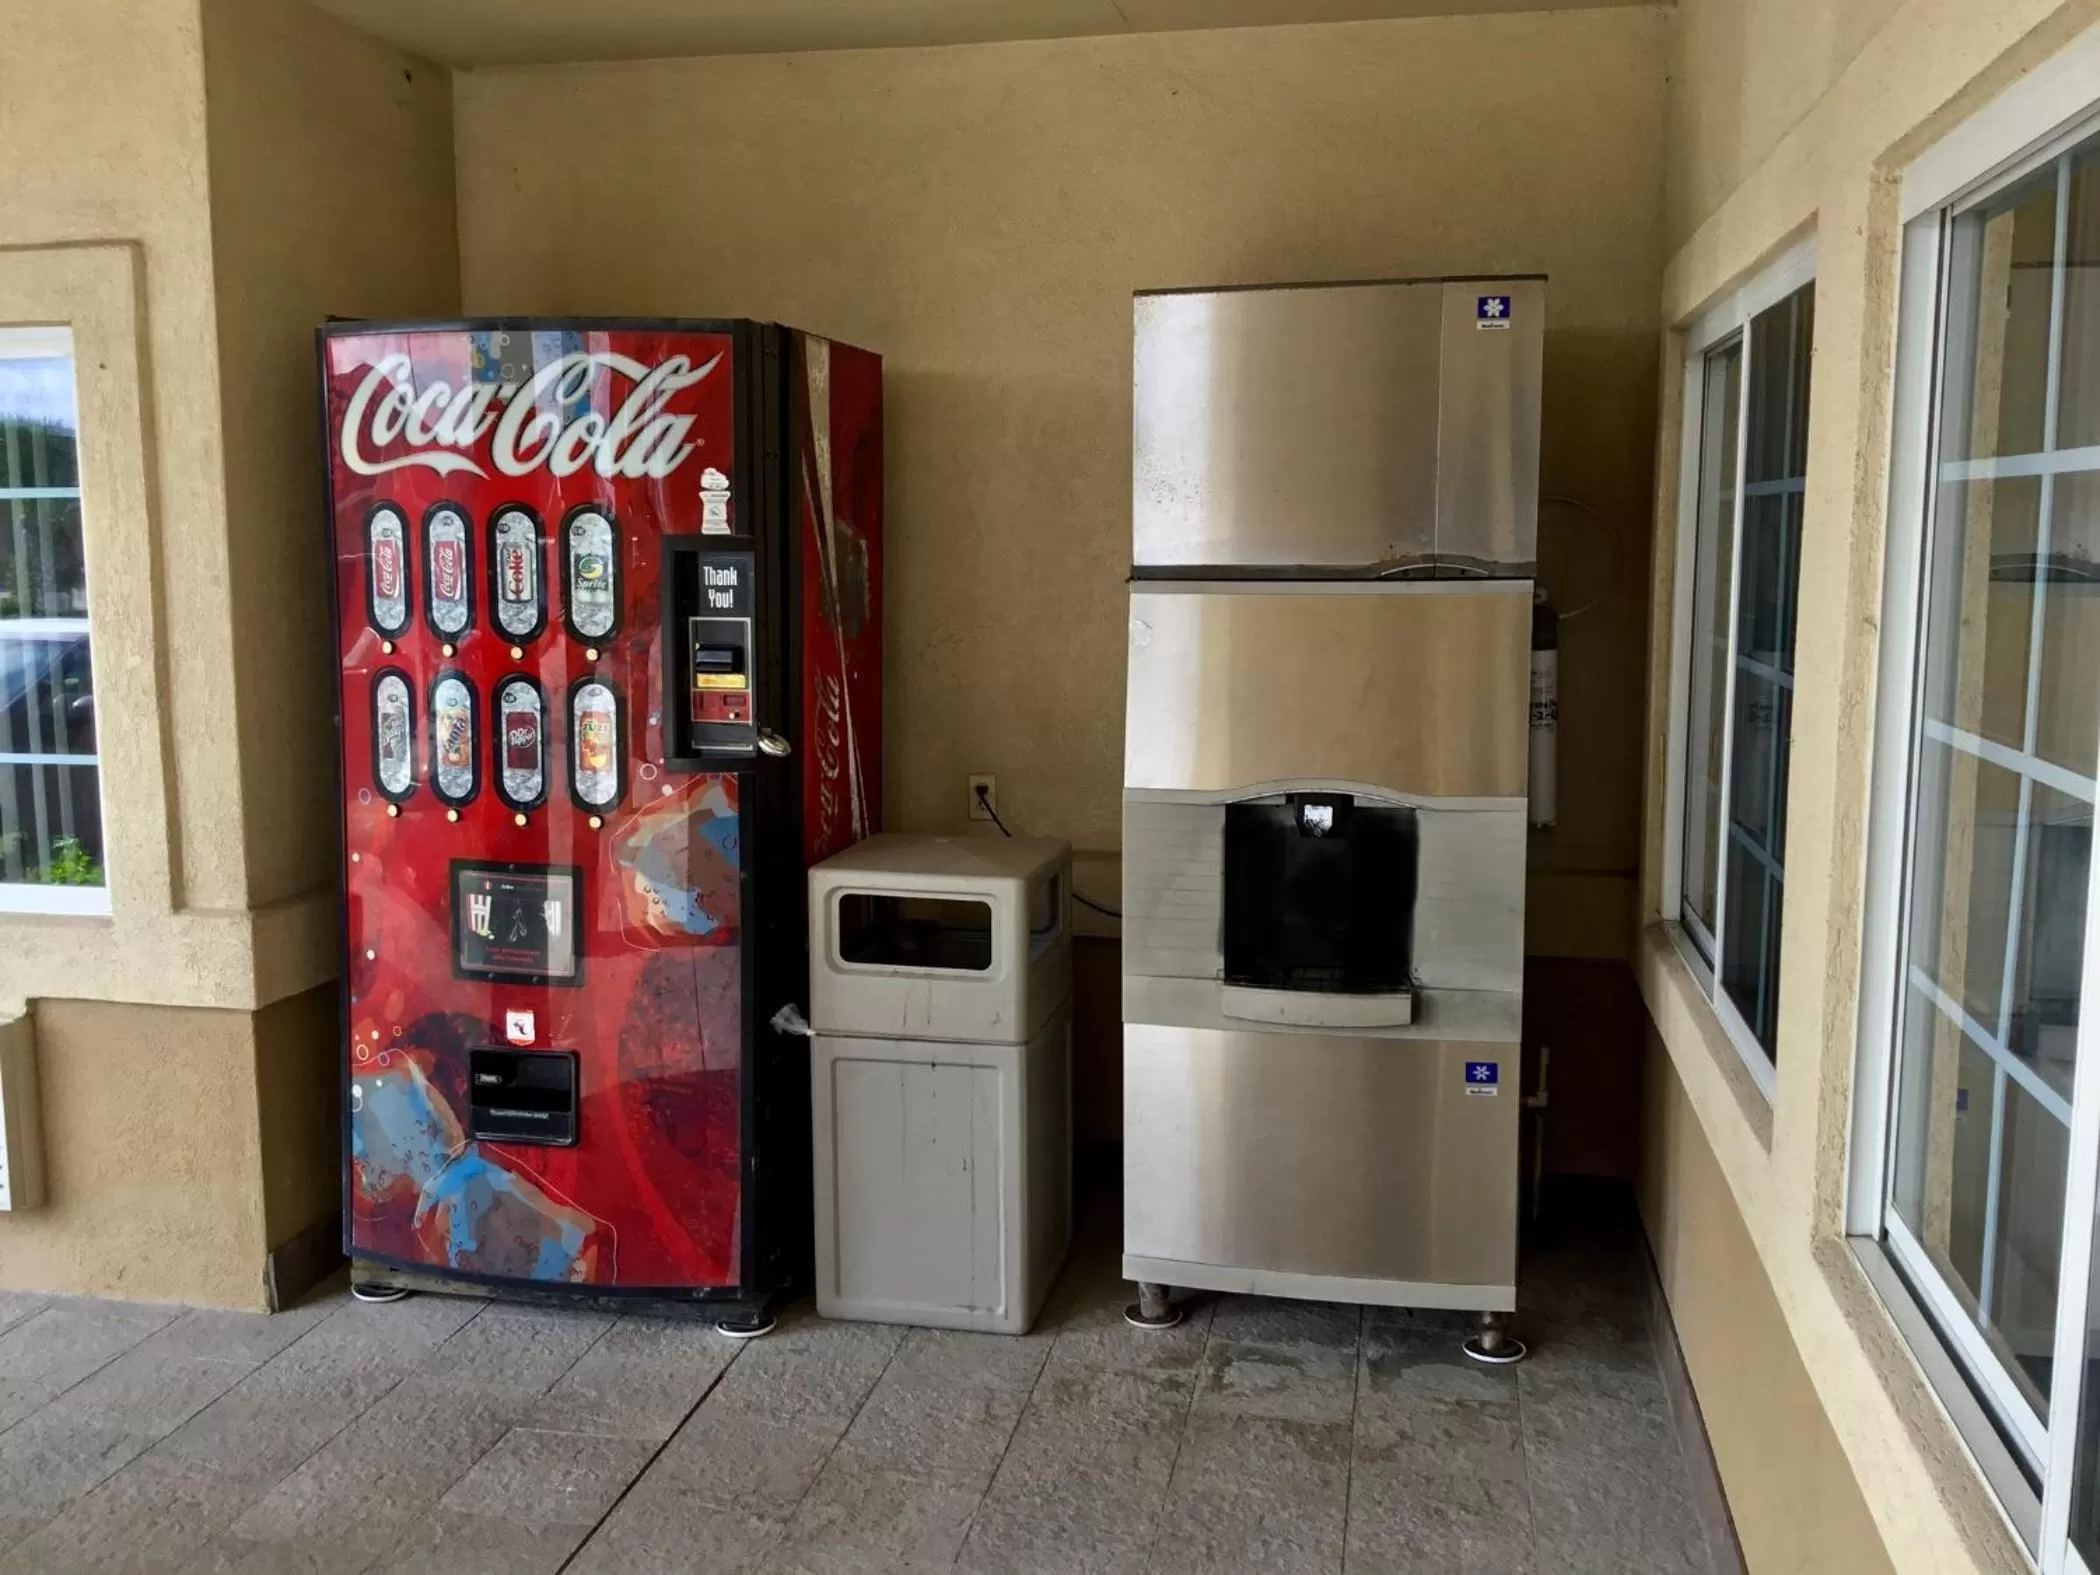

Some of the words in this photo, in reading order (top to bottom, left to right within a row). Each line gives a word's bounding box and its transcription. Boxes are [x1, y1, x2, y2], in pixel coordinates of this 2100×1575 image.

[340, 349, 724, 481] Coca-Cola
[380, 545, 394, 595] Coca-Cola
[440, 547, 453, 597] Coca-Cola
[508, 549, 524, 597] Coke
[703, 566, 738, 586] Thank
[708, 588, 734, 608] You!
